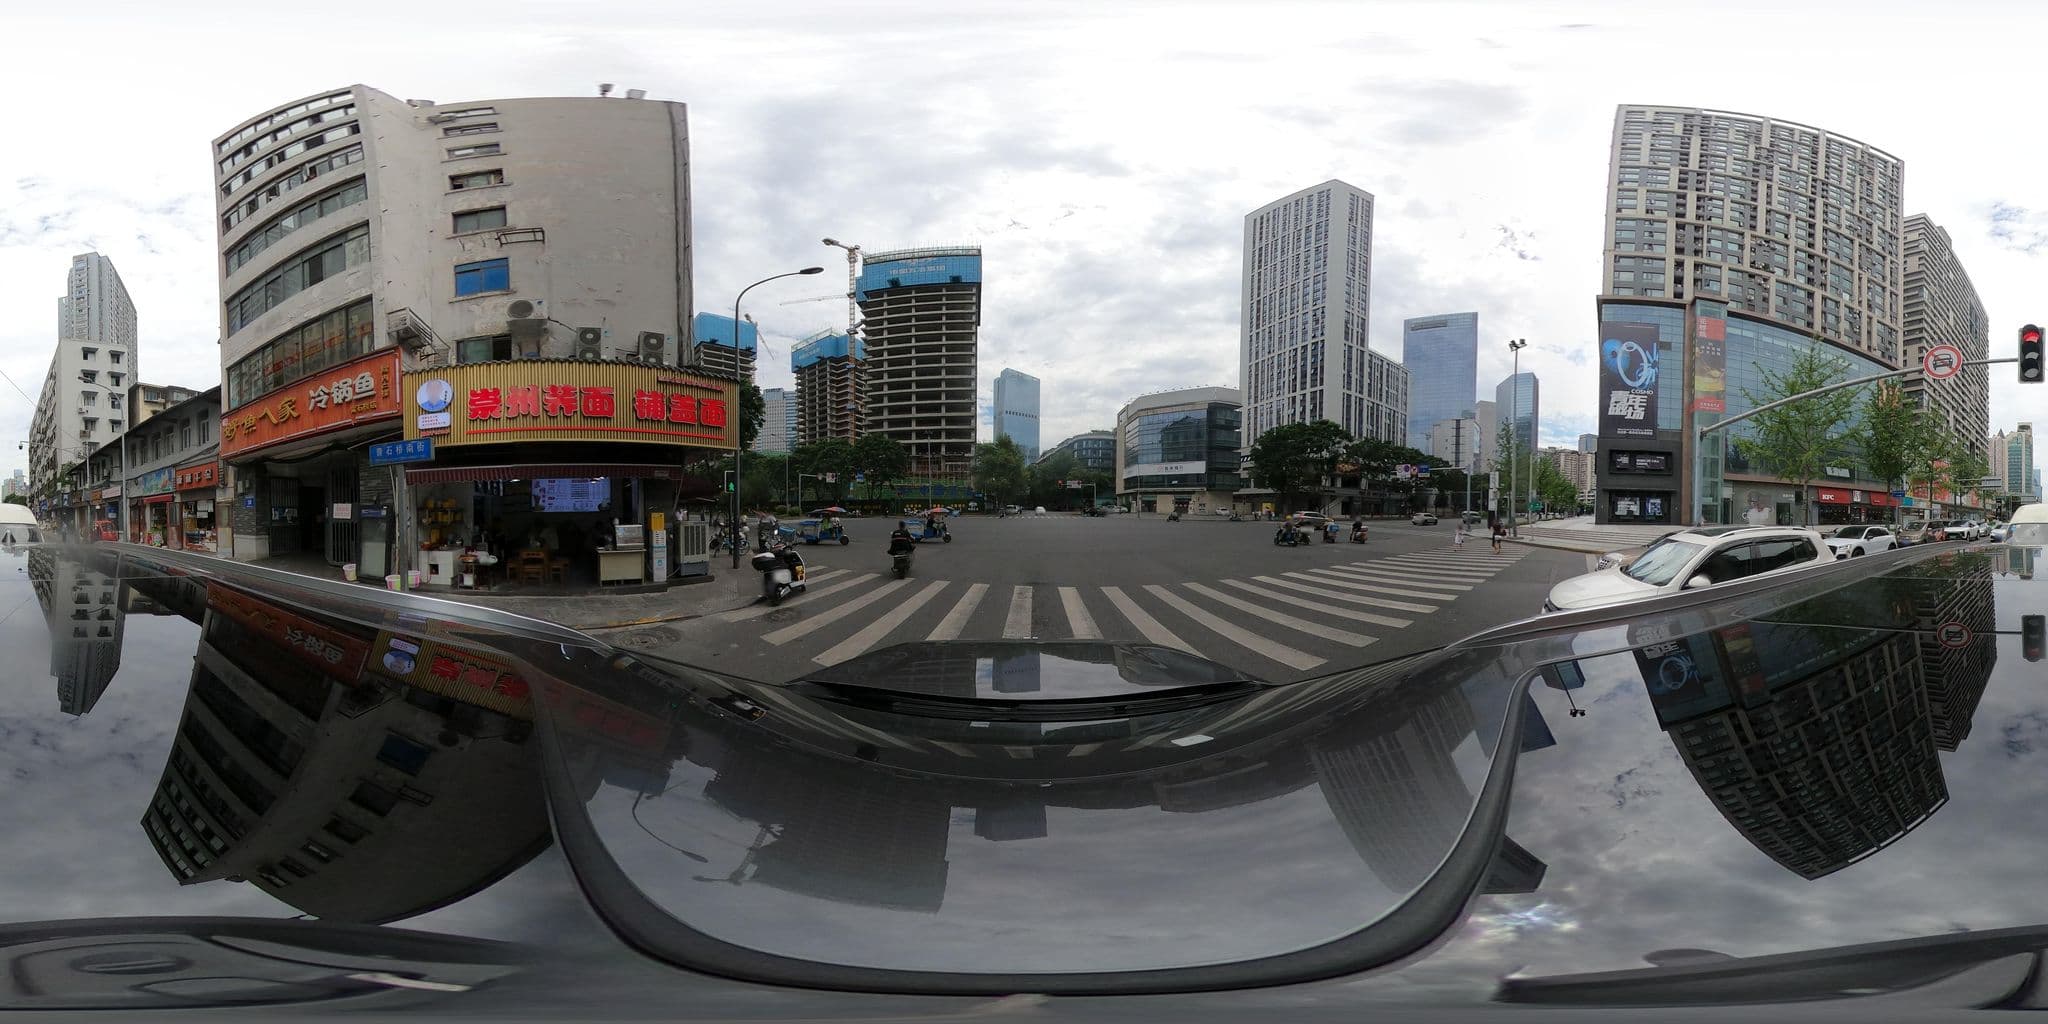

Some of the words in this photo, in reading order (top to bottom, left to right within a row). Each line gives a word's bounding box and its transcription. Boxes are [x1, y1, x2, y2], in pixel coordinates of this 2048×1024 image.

[309, 371, 376, 411] 冷锅鱼
[468, 384, 616, 420] 崇州荞面
